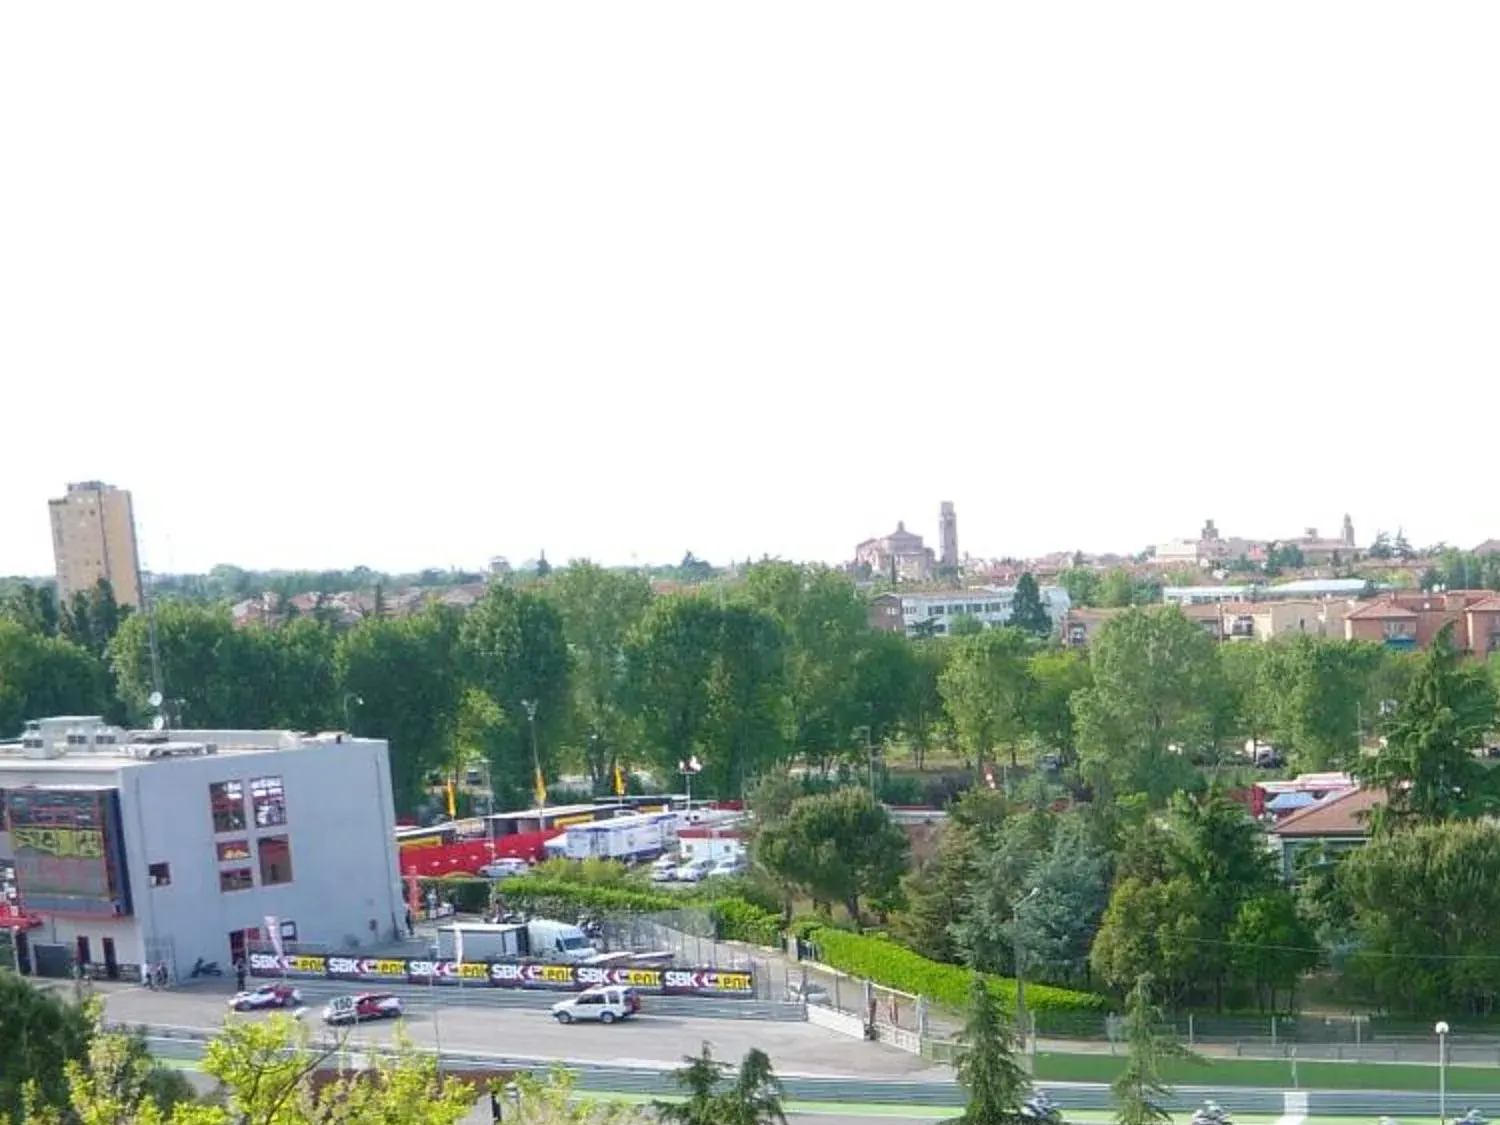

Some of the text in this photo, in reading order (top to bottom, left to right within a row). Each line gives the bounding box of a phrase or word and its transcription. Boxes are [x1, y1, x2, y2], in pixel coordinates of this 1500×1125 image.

[250, 953, 279, 968] SBK
[328, 957, 359, 973] SBK
[409, 961, 437, 976] SBK
[491, 964, 524, 979] SBK
[577, 968, 610, 984] SBK
[665, 971, 699, 987] SBK
